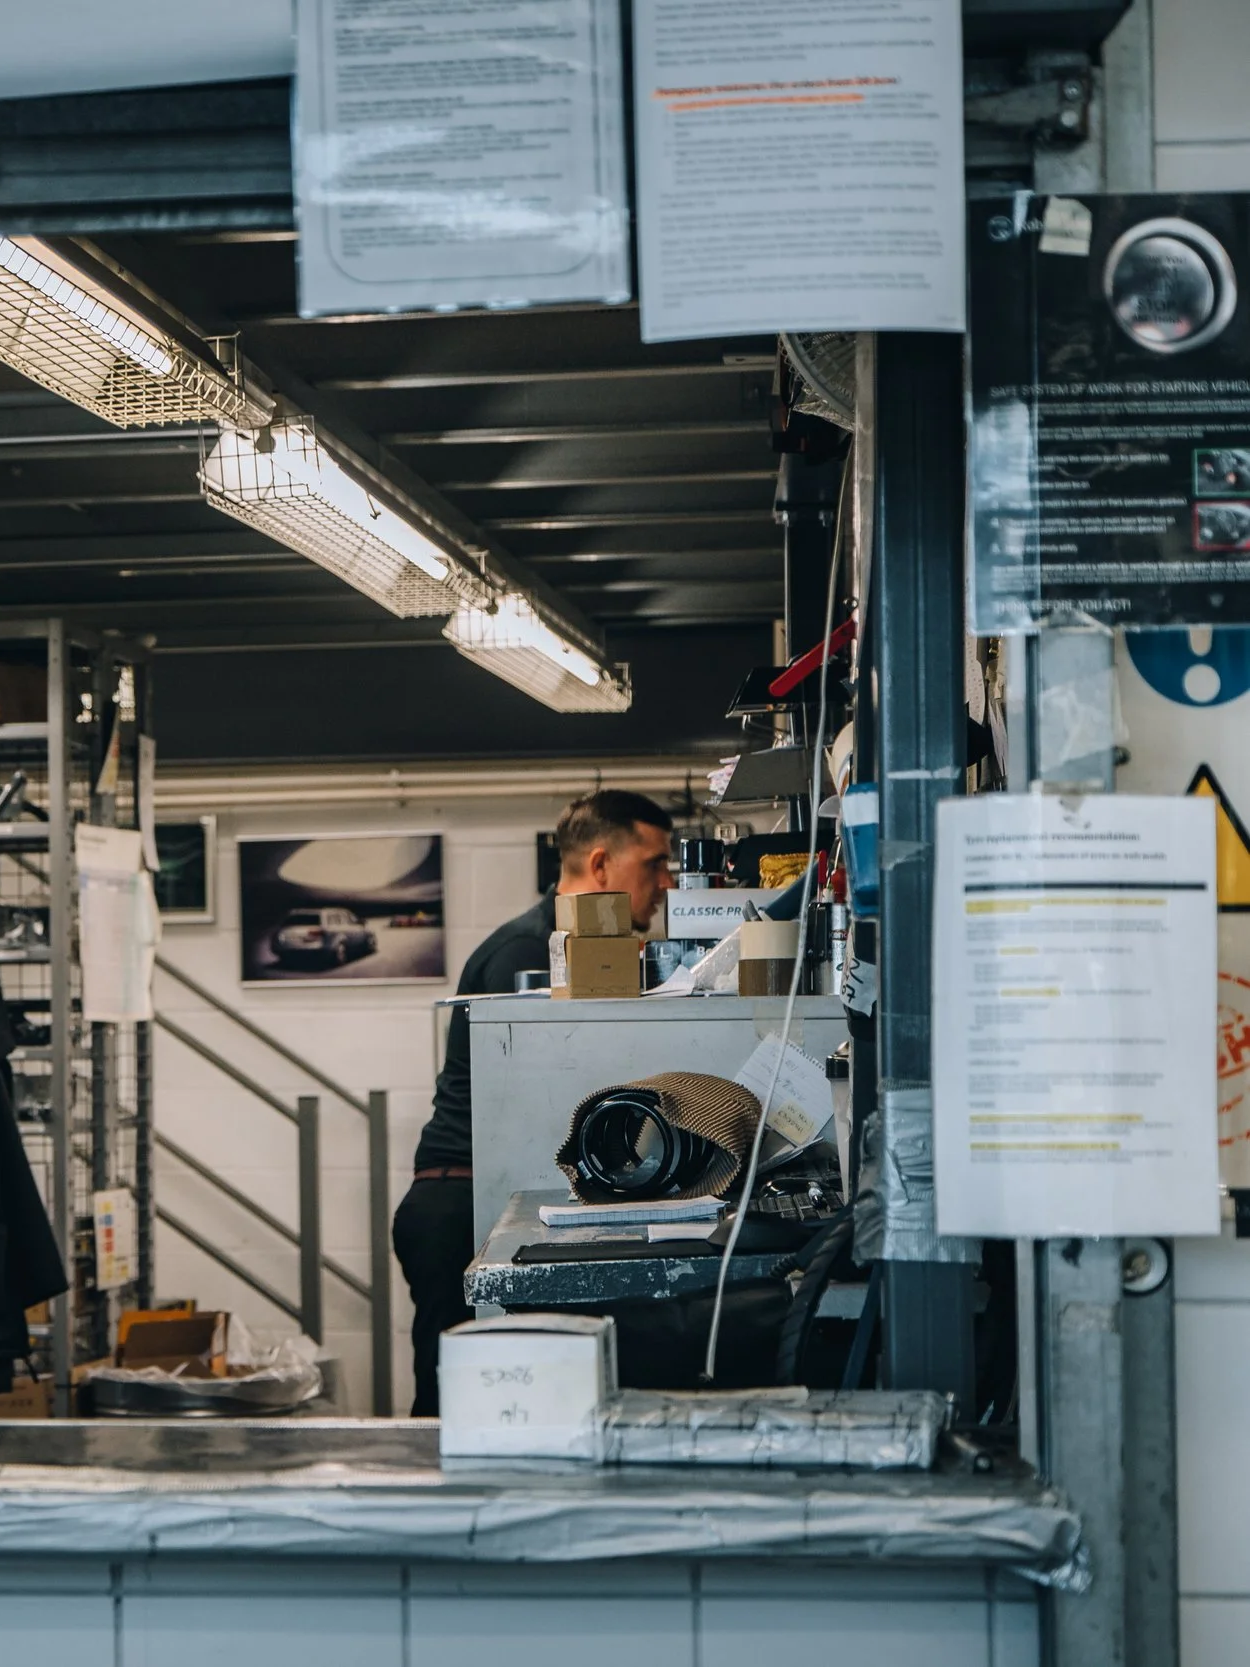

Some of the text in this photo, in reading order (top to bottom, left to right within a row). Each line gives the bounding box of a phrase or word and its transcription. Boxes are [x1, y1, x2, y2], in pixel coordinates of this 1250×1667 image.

[1021, 384, 1068, 397] SYSTEM
[1071, 383, 1086, 395] OF
[1088, 382, 1123, 394] WORK
[1126, 382, 1150, 393] FOR
[1152, 381, 1208, 393] STARTING
[1077, 599, 1100, 611] YOU
